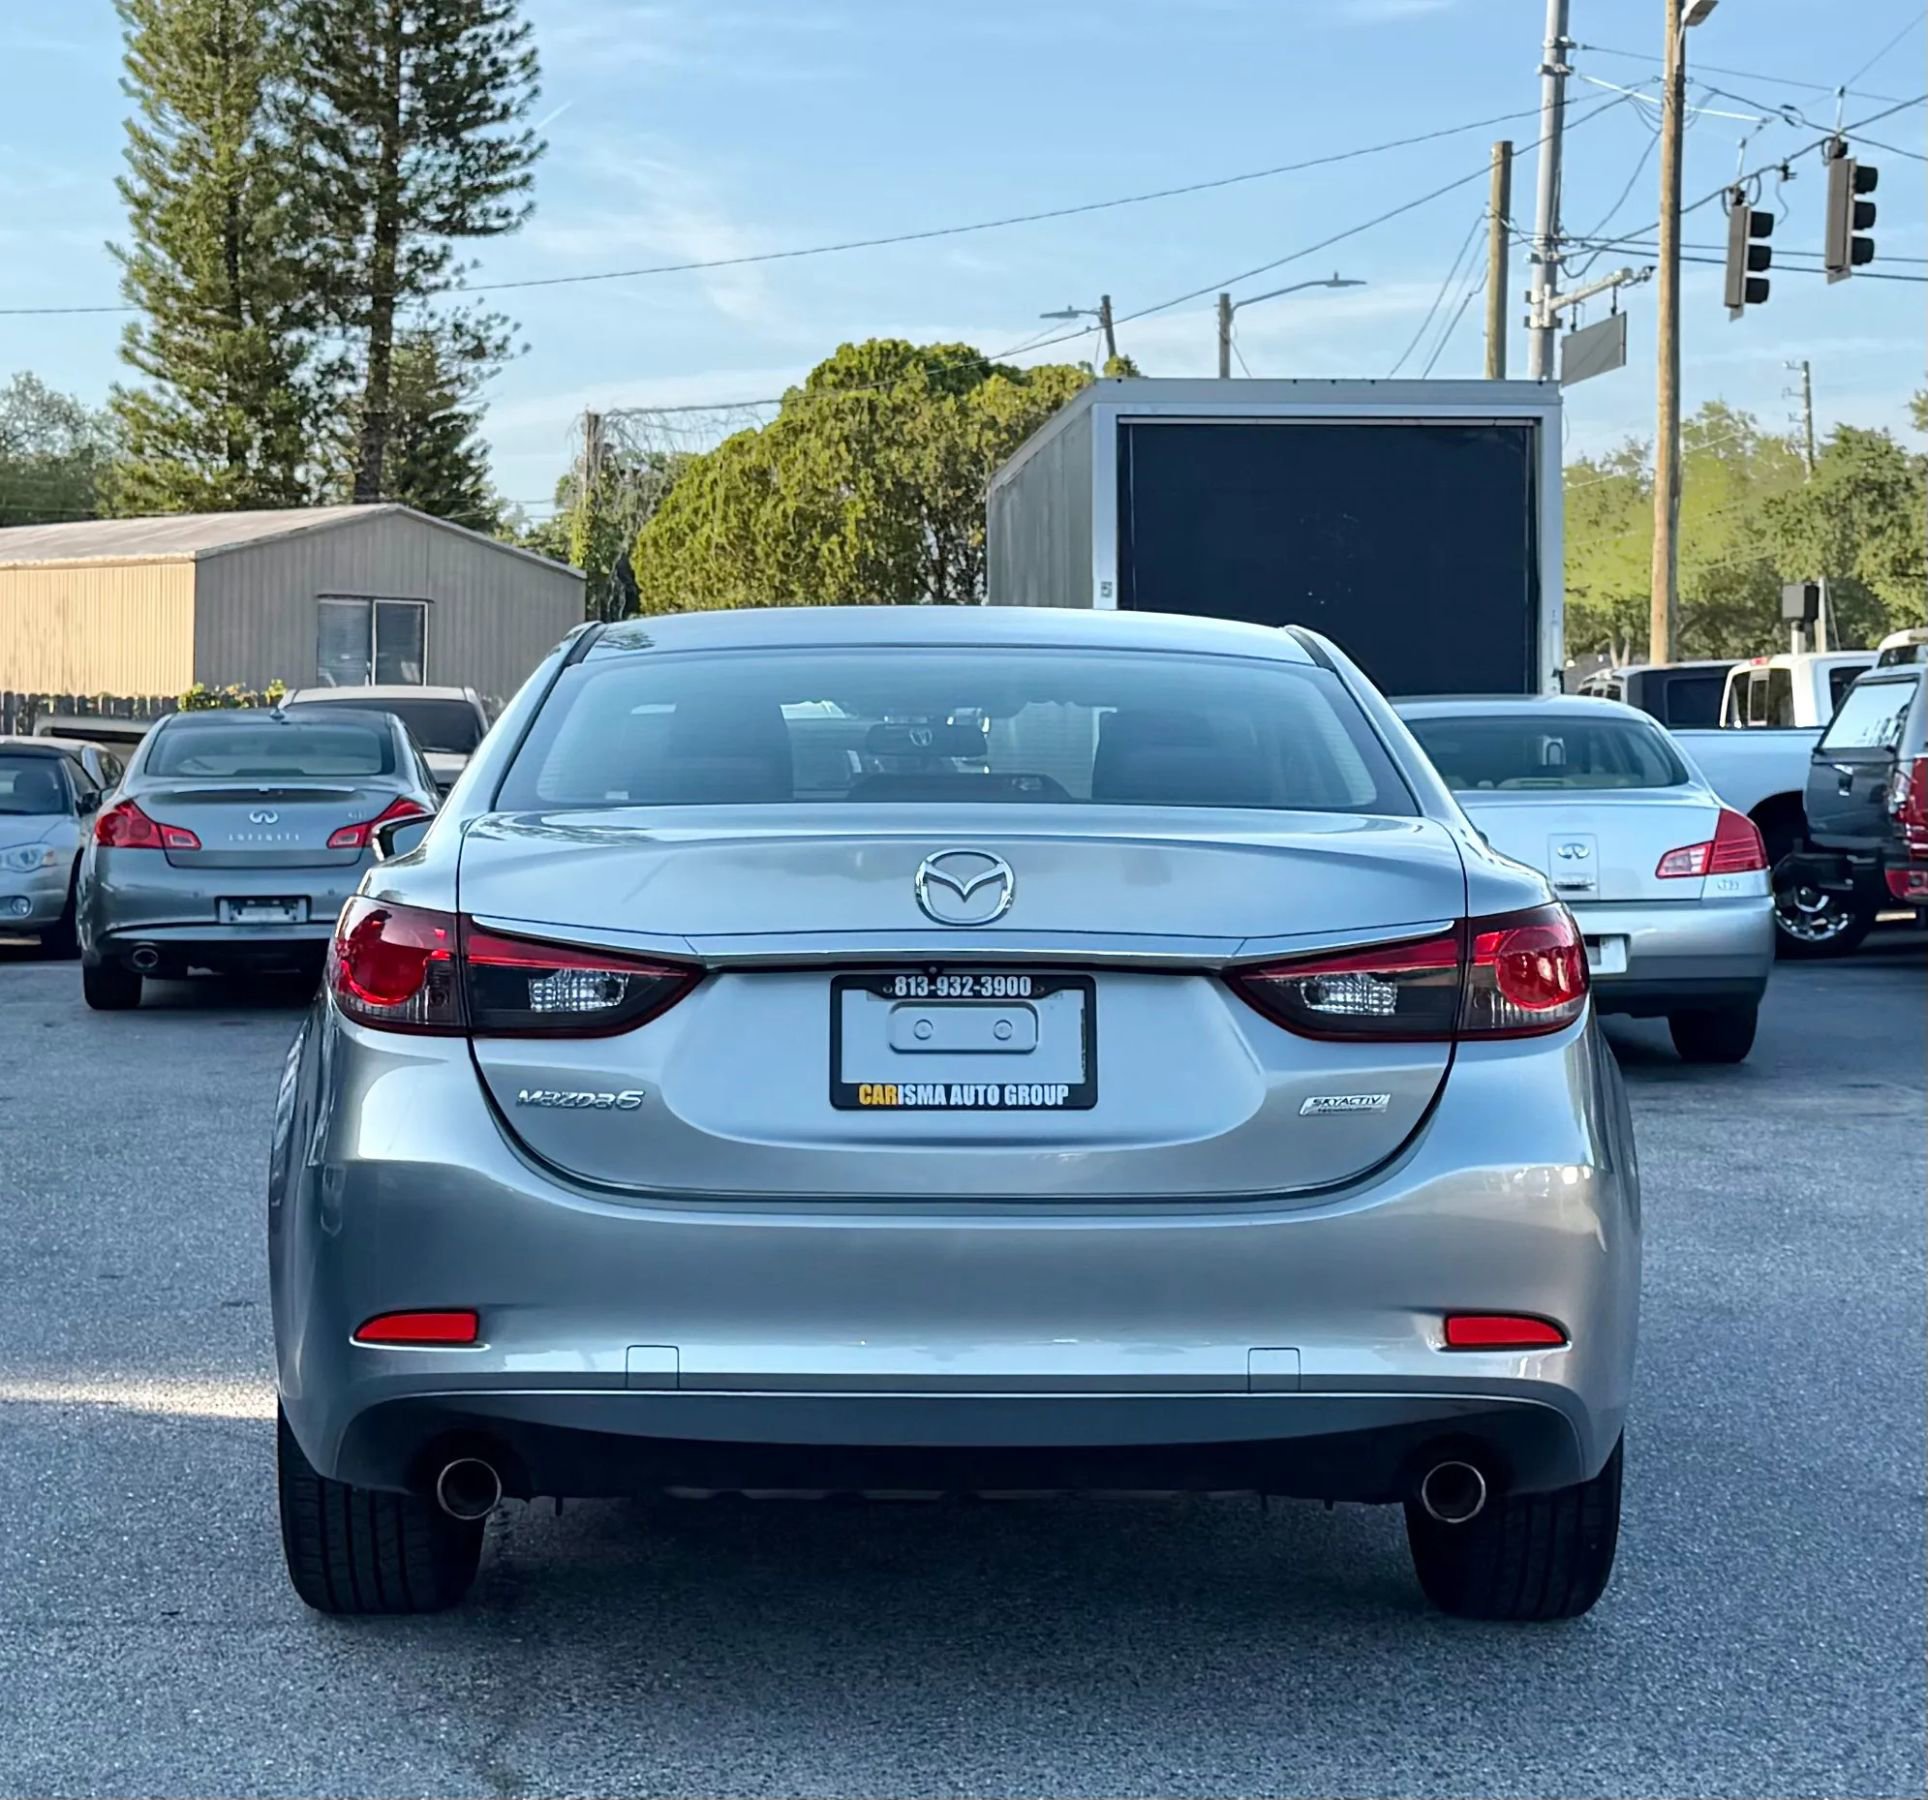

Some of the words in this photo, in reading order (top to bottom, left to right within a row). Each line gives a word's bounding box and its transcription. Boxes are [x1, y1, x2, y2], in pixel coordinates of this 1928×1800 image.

[894, 976, 1031, 997] 813-932-3900
[858, 1084, 946, 1106] CARISMA
[950, 1084, 1000, 1106] AUTO
[1004, 1084, 1069, 1106] GROUP
